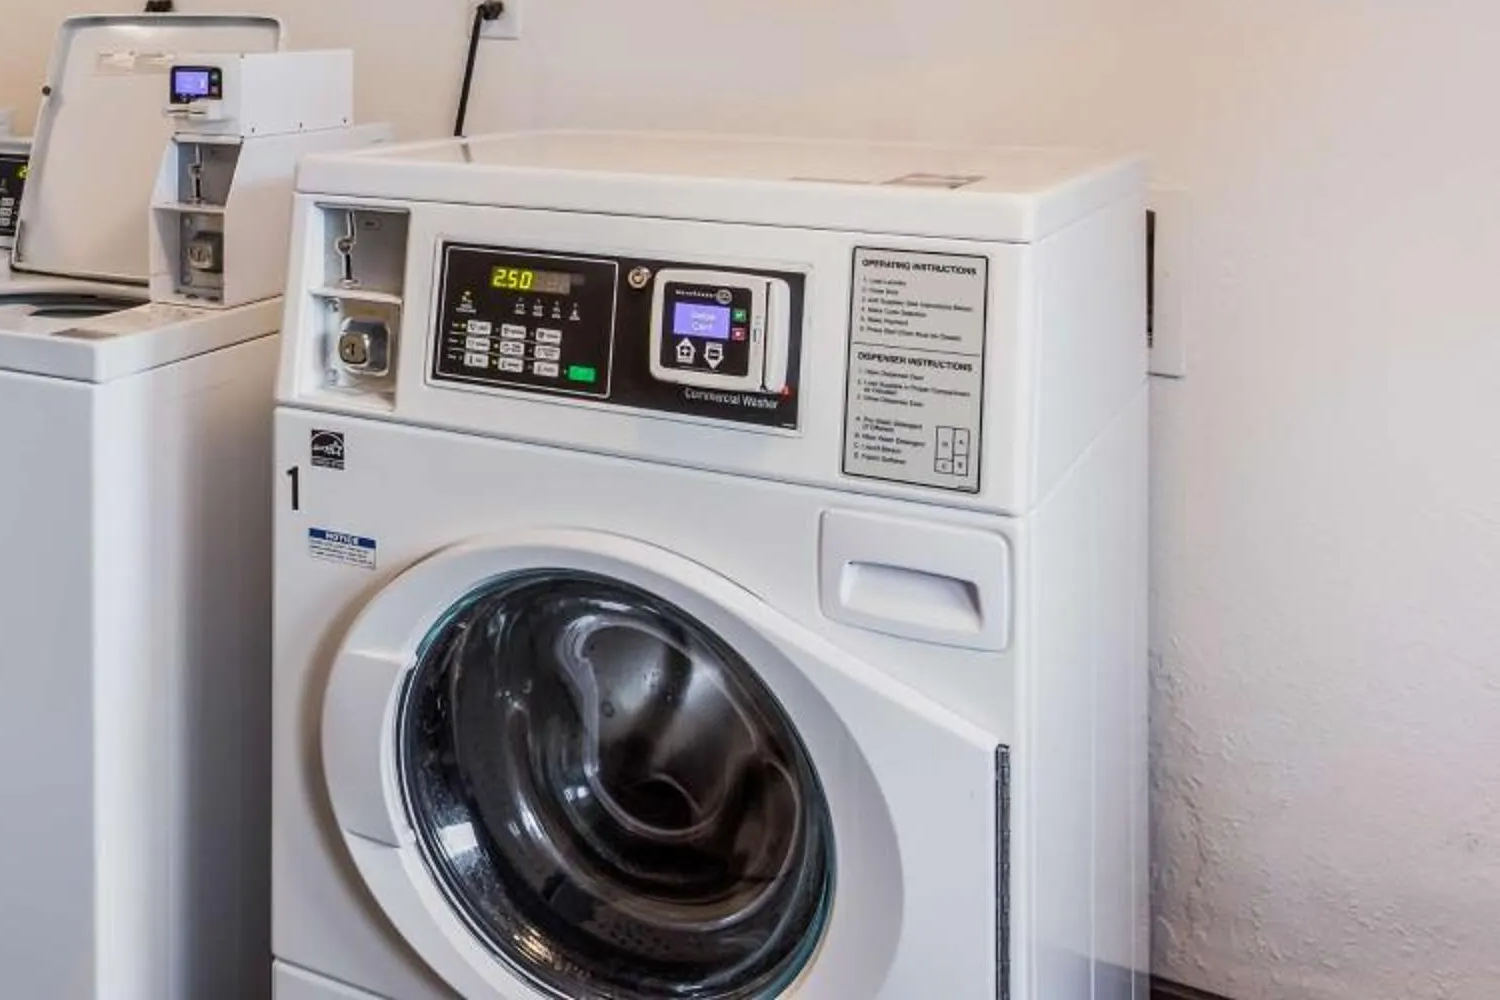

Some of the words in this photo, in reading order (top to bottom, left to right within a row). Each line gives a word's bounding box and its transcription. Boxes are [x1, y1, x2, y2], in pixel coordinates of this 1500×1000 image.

[861, 259, 910, 270] OPERATING
[912, 263, 977, 275] INSTRUCTIONS
[857, 352, 906, 364] DISPENSER
[908, 357, 973, 371] INSTRUCTIONS
[684, 387, 741, 406] Commercial
[742, 395, 778, 409] Washer
[286, 466, 299, 510] 1
